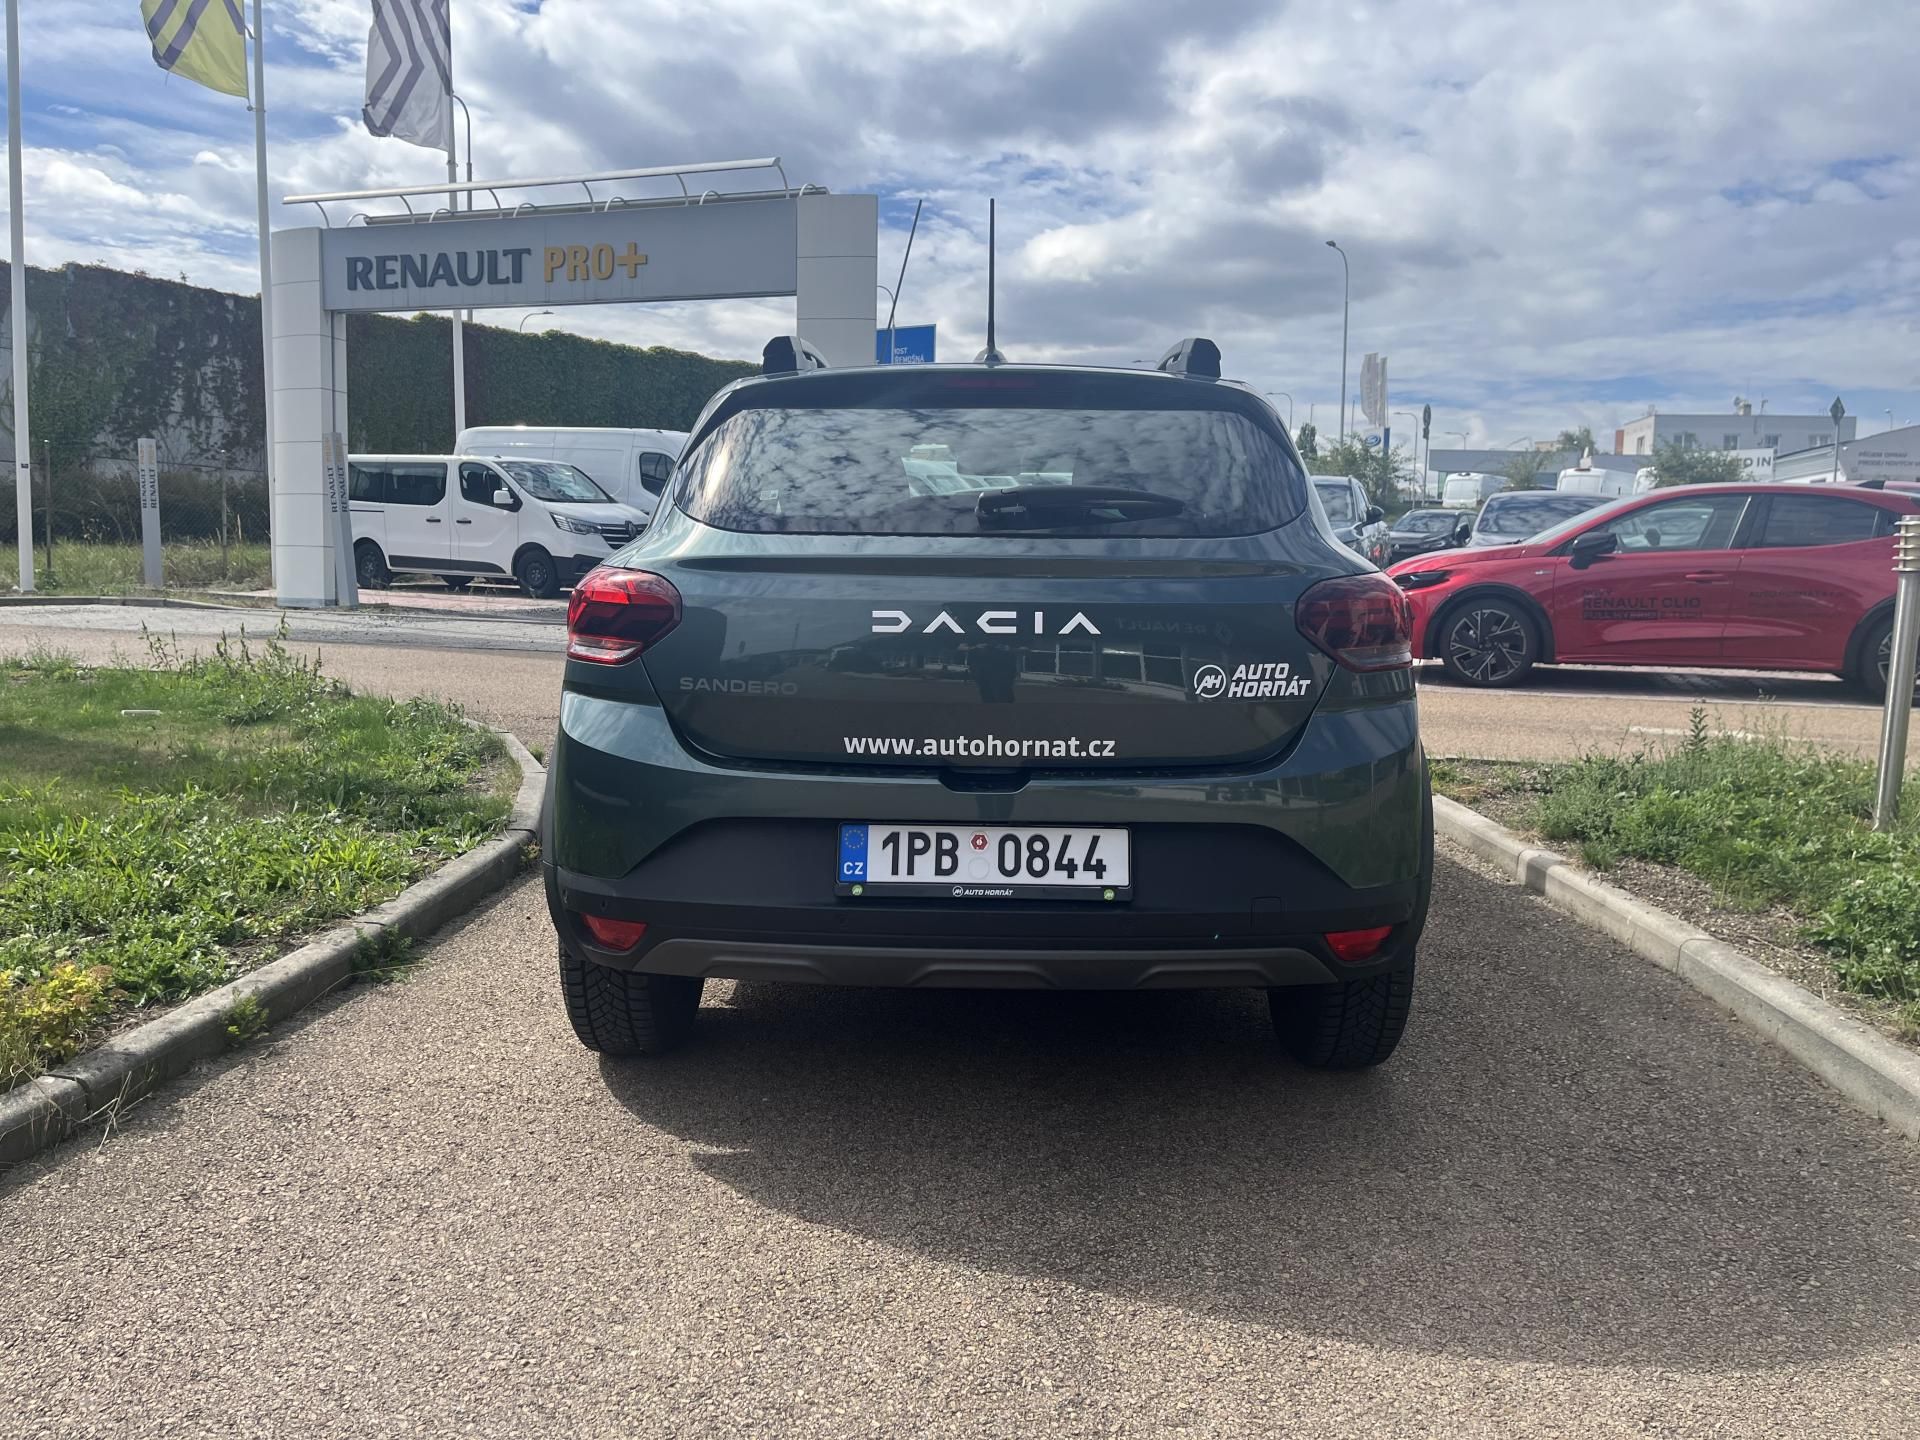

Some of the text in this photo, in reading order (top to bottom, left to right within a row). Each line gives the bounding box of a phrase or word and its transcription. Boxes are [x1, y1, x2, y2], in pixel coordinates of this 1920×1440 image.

[346, 241, 647, 291] RENAULT PRO+
[1756, 455, 1772, 467] IN
[148, 468, 157, 509] RENAULT
[327, 465, 338, 513] RENAULT
[337, 465, 349, 513] RENAULT
[1584, 597, 1701, 609] RENAULT CLIO
[871, 610, 1101, 634] DACIA
[1231, 662, 1290, 681] AUTO
[679, 677, 799, 696] SANDERO
[1227, 675, 1312, 698] HORNÁT
[842, 734, 1116, 758] www.autohornat.cz
[881, 831, 1107, 880] 1PB 0844
[843, 861, 864, 875] CZ
[984, 888, 1014, 896] HORNÁT
